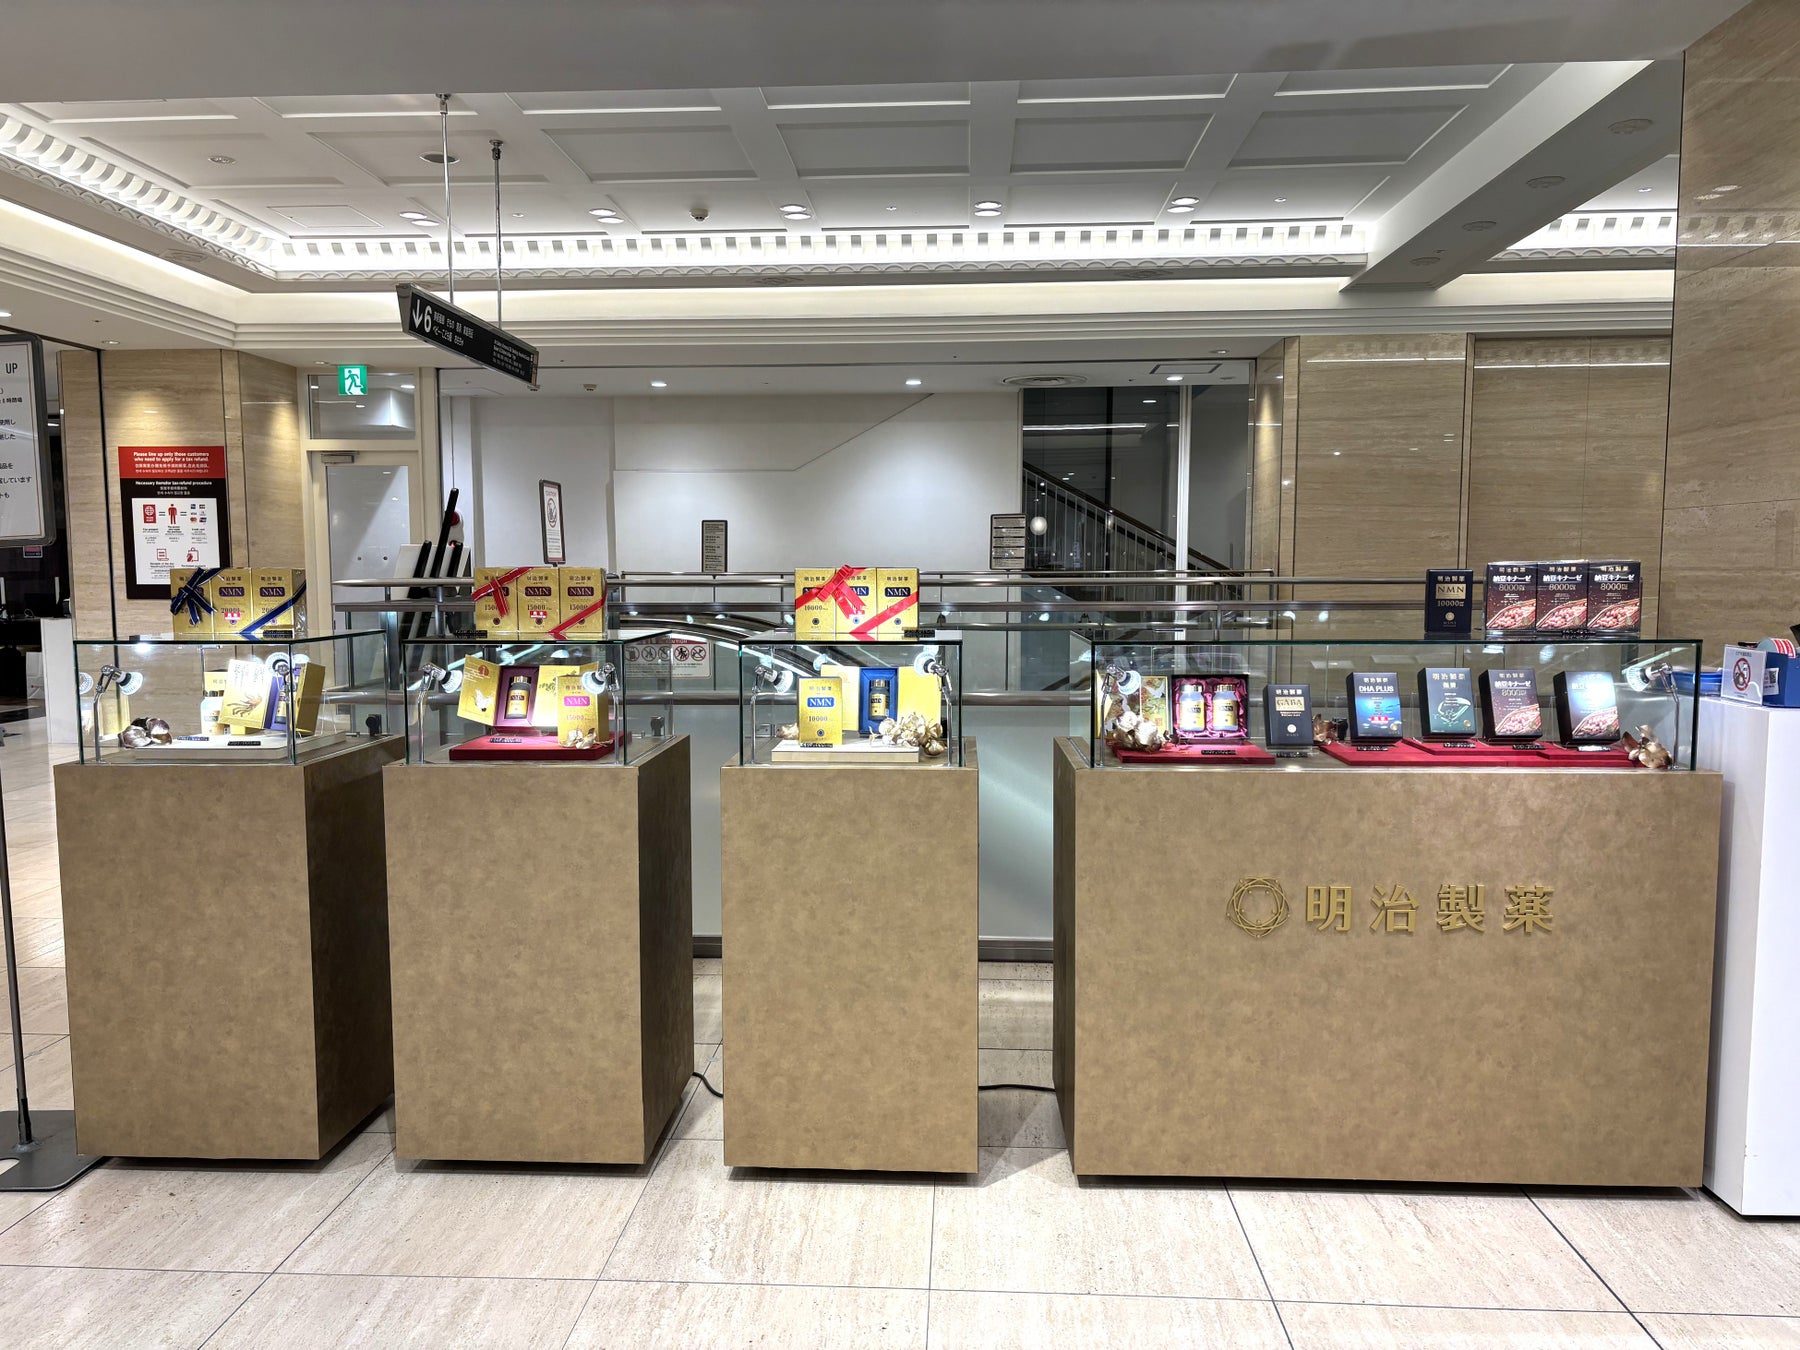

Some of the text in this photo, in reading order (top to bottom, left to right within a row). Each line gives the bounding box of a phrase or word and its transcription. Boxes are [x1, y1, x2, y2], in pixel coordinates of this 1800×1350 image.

[424, 305, 432, 333] 6
[5, 362, 18, 374] UP
[220, 588, 243, 596] NMN
[261, 588, 284, 596] NMN
[527, 587, 550, 595] NMN
[569, 587, 593, 595] NMN
[887, 588, 909, 596] NMN
[566, 697, 588, 705] NMN
[809, 698, 833, 706] NMN
[1305, 883, 1554, 933] 明治製薬
